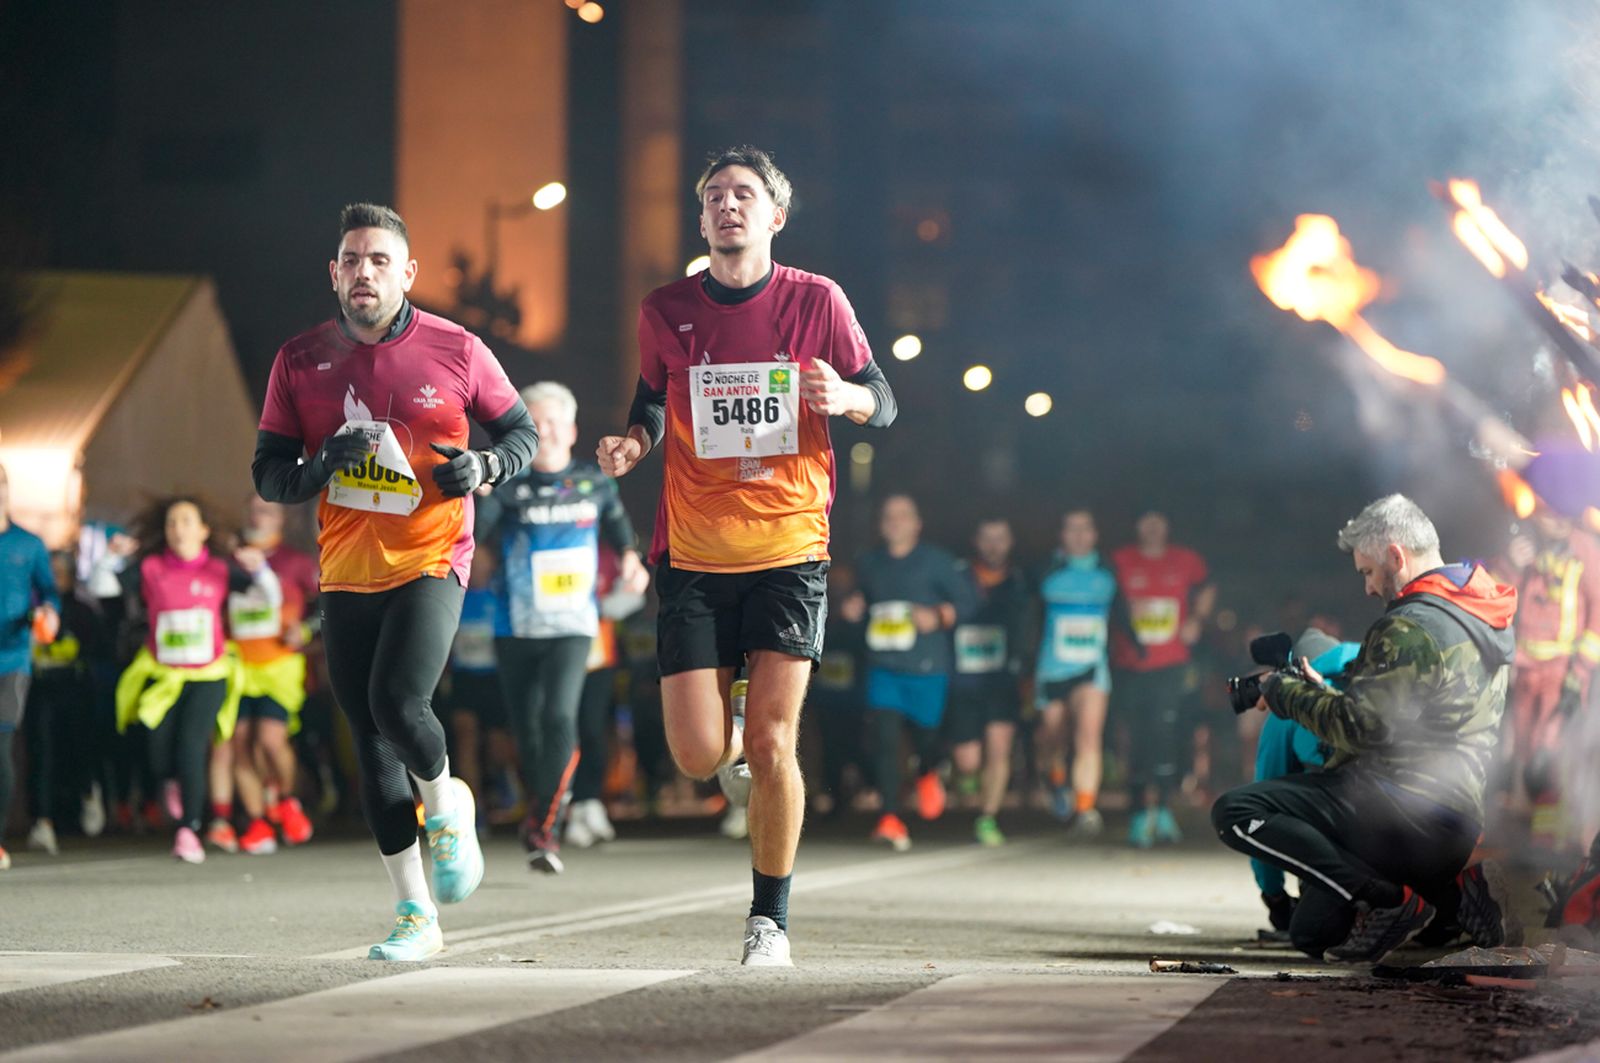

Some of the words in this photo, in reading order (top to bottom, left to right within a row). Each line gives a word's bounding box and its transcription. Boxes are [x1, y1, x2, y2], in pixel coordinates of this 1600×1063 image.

[715, 374, 746, 384] NOCHE
[747, 373, 760, 383] DE
[704, 387, 723, 397] SAN
[712, 397, 779, 425] 5486
